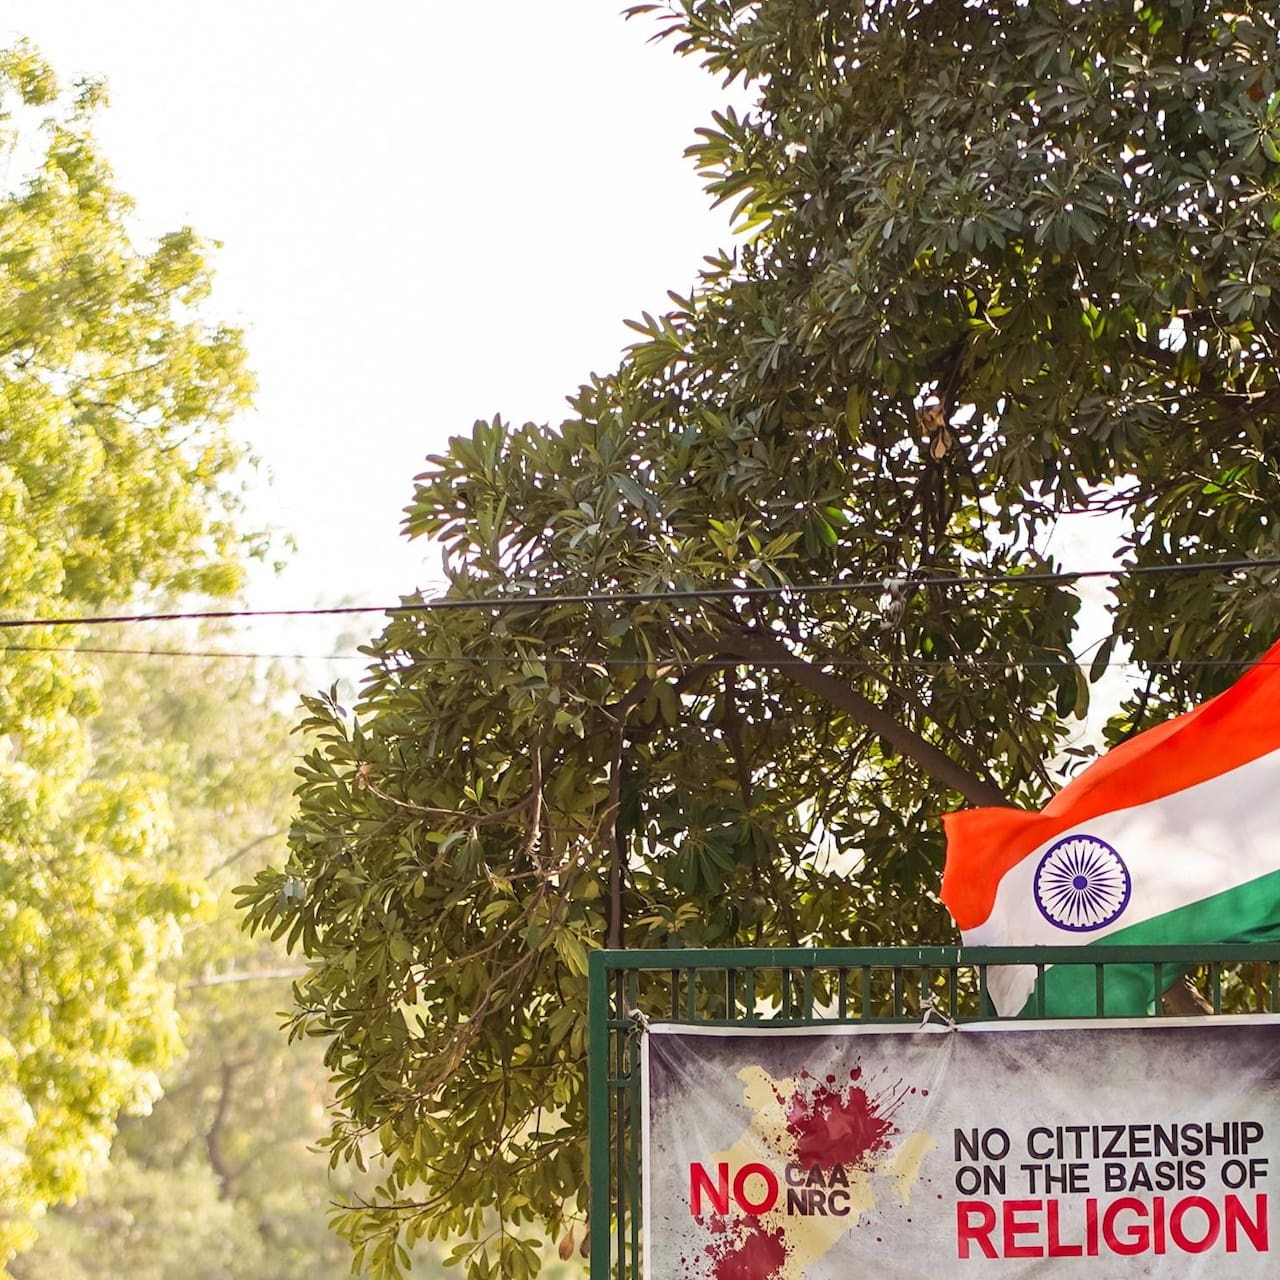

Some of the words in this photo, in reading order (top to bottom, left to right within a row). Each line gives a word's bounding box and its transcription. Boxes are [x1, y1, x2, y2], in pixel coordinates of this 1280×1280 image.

[954, 1127, 1011, 1161] NO
[1026, 1122, 1264, 1160] CITIZENSHIP
[689, 1162, 779, 1216] NO
[784, 1163, 850, 1188] CAA
[955, 1165, 1006, 1195] ON
[1020, 1163, 1090, 1194] THE
[1104, 1160, 1206, 1192] BASIS
[1221, 1158, 1269, 1189] OF
[786, 1188, 851, 1216] NRC
[956, 1194, 1269, 1259] RELIGION
